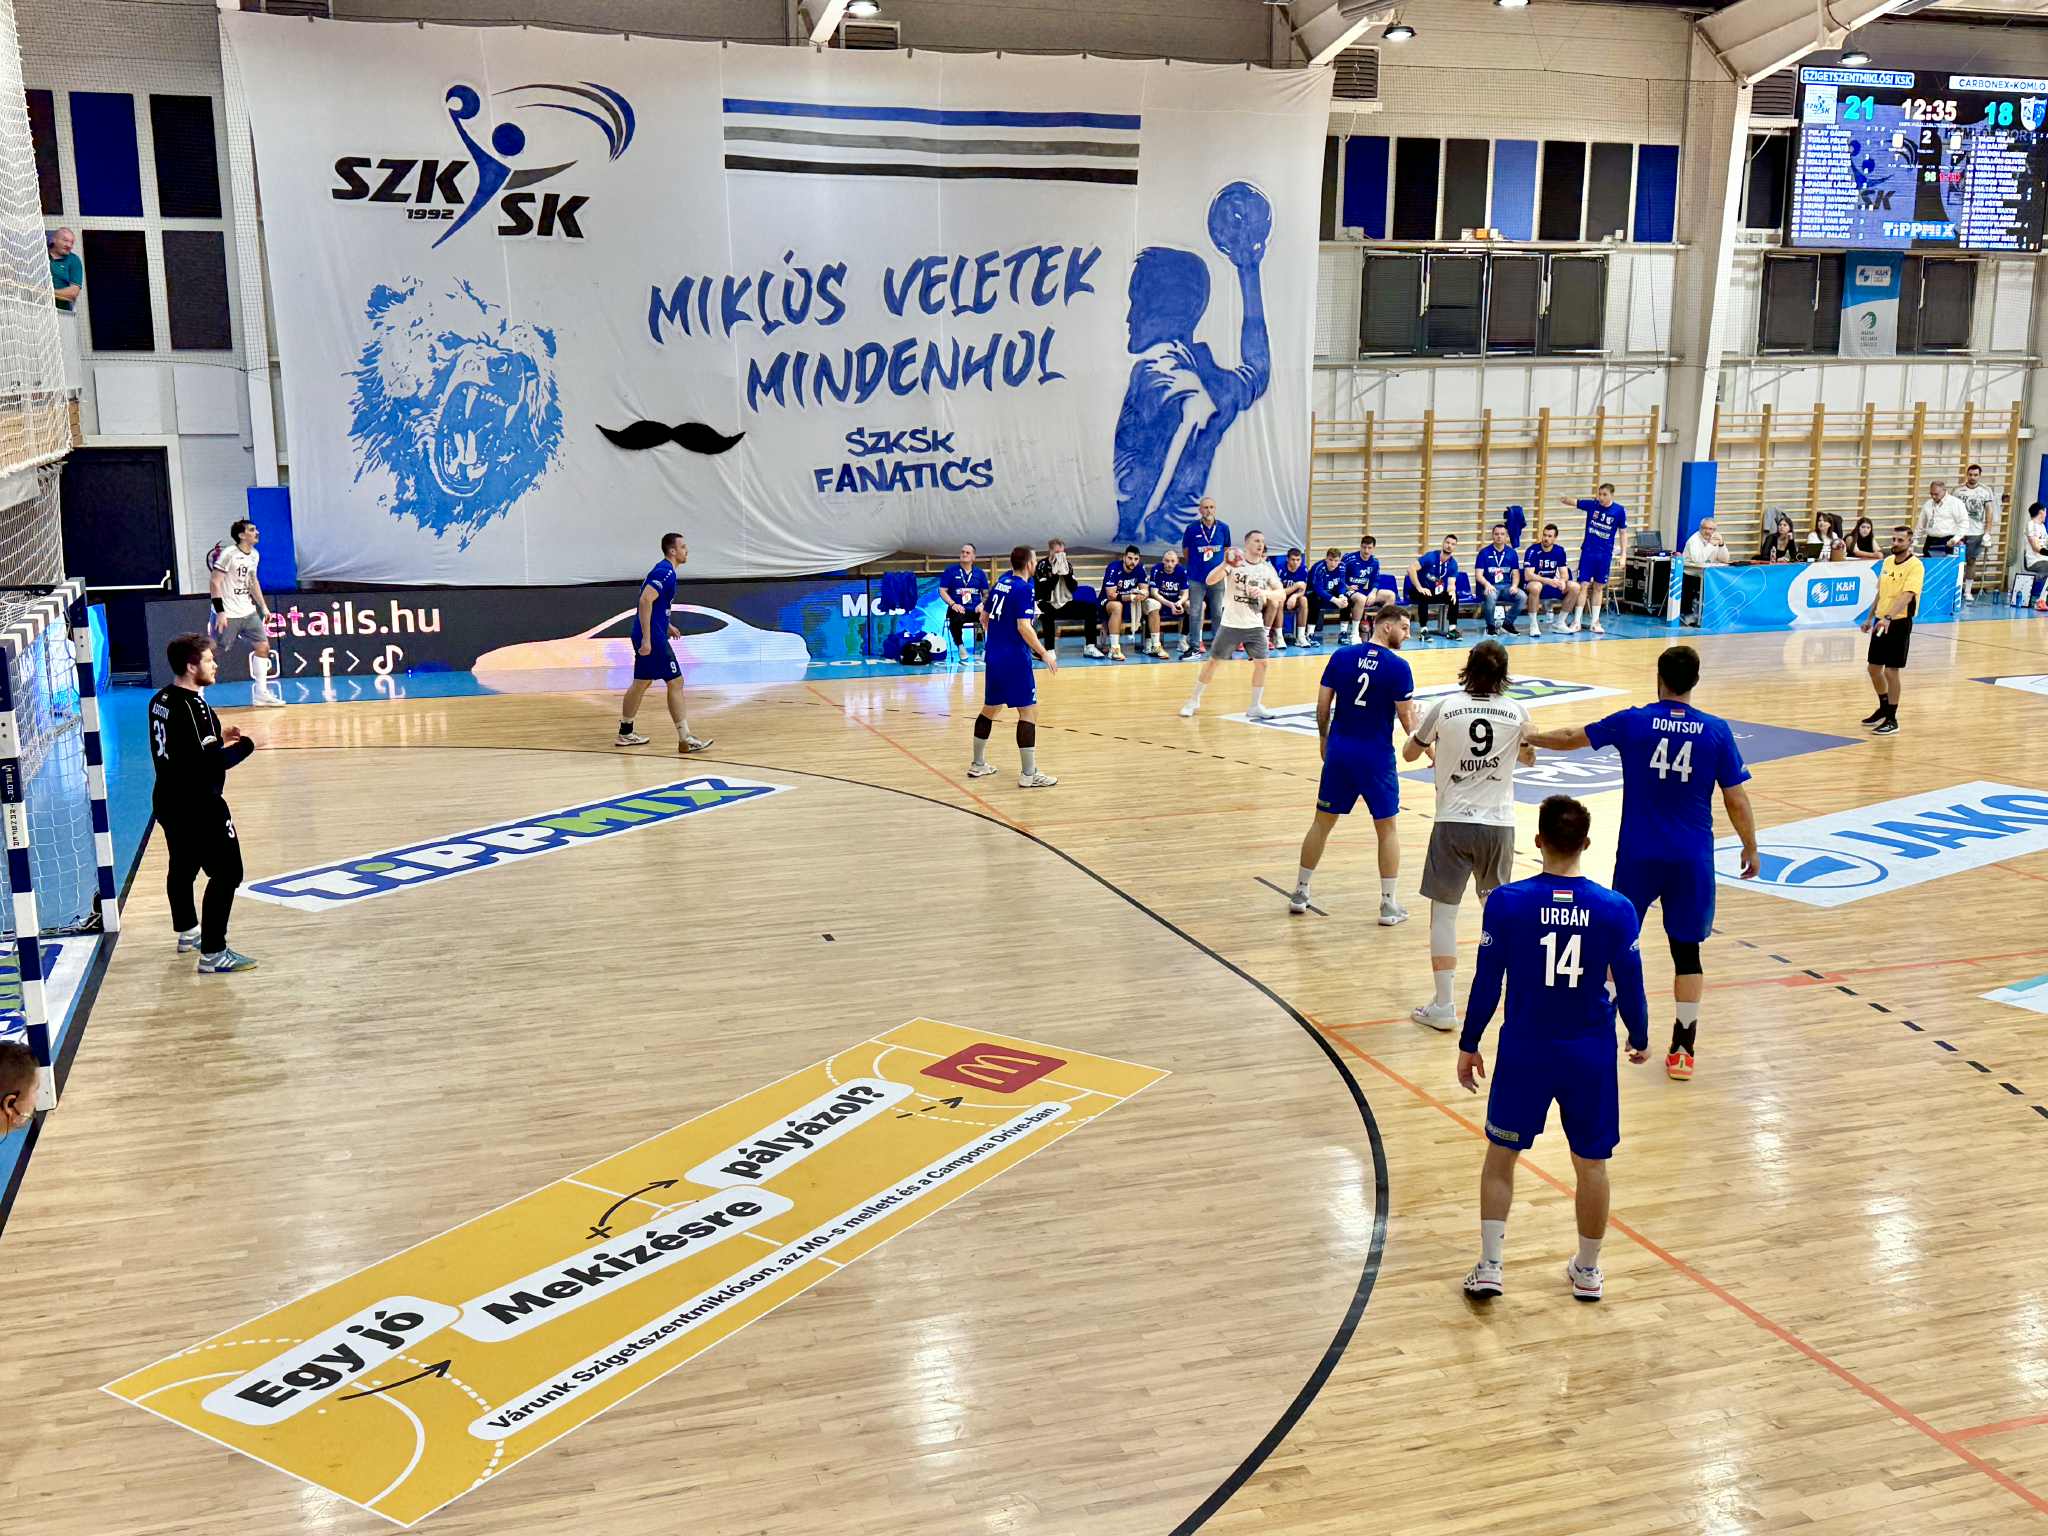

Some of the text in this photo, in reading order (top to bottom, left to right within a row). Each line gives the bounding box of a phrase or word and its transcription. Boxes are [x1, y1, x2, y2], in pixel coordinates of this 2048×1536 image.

[1895, 75, 1912, 85] KSK
[1844, 95, 1875, 120] 21
[1902, 98, 1957, 121] 12:35
[1984, 101, 2014, 126] 18
[1921, 130, 1932, 144] 2
[332, 156, 470, 204] SZK
[406, 208, 455, 220] 1992
[497, 192, 591, 239] SK
[647, 245, 1102, 344] MIKLÓS VELETEK
[746, 325, 1067, 413] MINDENHOL
[845, 426, 956, 458] SZKSK
[236, 566, 248, 577] 19
[1234, 572, 1247, 585] 34
[1836, 580, 1856, 592] K&H
[263, 600, 441, 637] etails.hu
[988, 593, 1005, 622] 24
[670, 661, 677, 674] 9
[1354, 673, 1370, 707] 2
[1469, 718, 1494, 757] 9
[1652, 717, 1704, 735] DONTSOV
[1649, 738, 1693, 783] 44
[1540, 905, 1590, 927] URBÁN
[1540, 931, 1584, 988] 14
[720, 1085, 885, 1180] pályázol?
[481, 1200, 763, 1326] Mekizésre
[487, 1381, 578, 1430] Várunk
[572, 1265, 784, 1382] Szigetszentmiklóson,
[778, 1252, 804, 1266] az
[843, 1195, 903, 1230] mellett
[898, 1184, 922, 1198] és
[917, 1178, 933, 1187] a
[926, 1142, 996, 1179] Campona
[990, 1106, 1061, 1144] Drive-ban.
[233, 1310, 424, 1408] Egy jó
